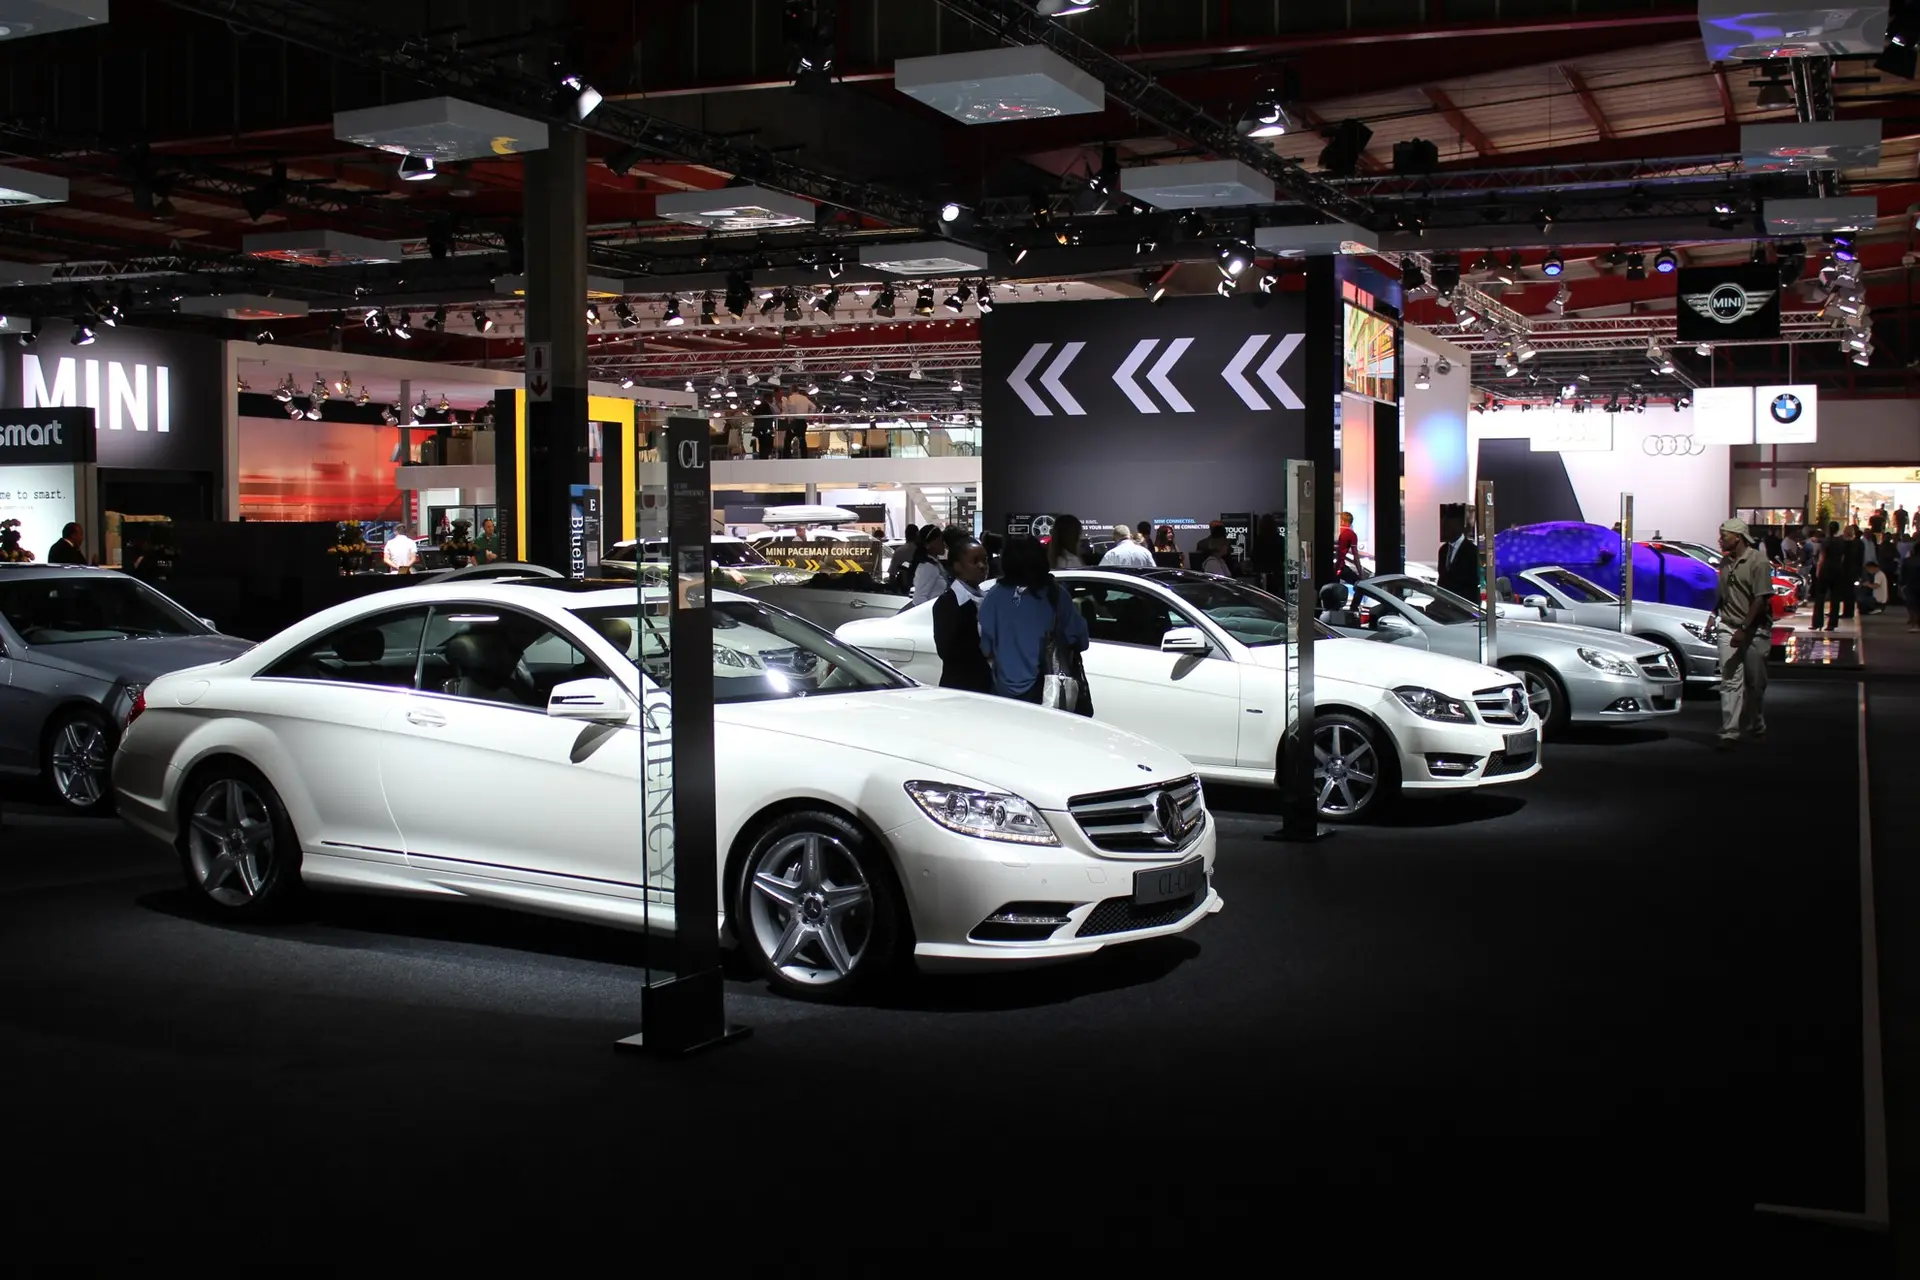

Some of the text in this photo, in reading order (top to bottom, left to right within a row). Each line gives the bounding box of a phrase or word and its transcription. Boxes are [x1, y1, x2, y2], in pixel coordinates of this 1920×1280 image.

[1713, 297, 1741, 308] MINI
[22, 354, 170, 432] MINI
[0, 420, 62, 446] smart
[678, 440, 704, 469] CL
[17, 490, 28, 499] to
[34, 489, 66, 499] smart.
[589, 499, 596, 511] E
[1225, 526, 1248, 534] TOUCH
[766, 547, 873, 556] MINI PACEMAN CONCEPT.
